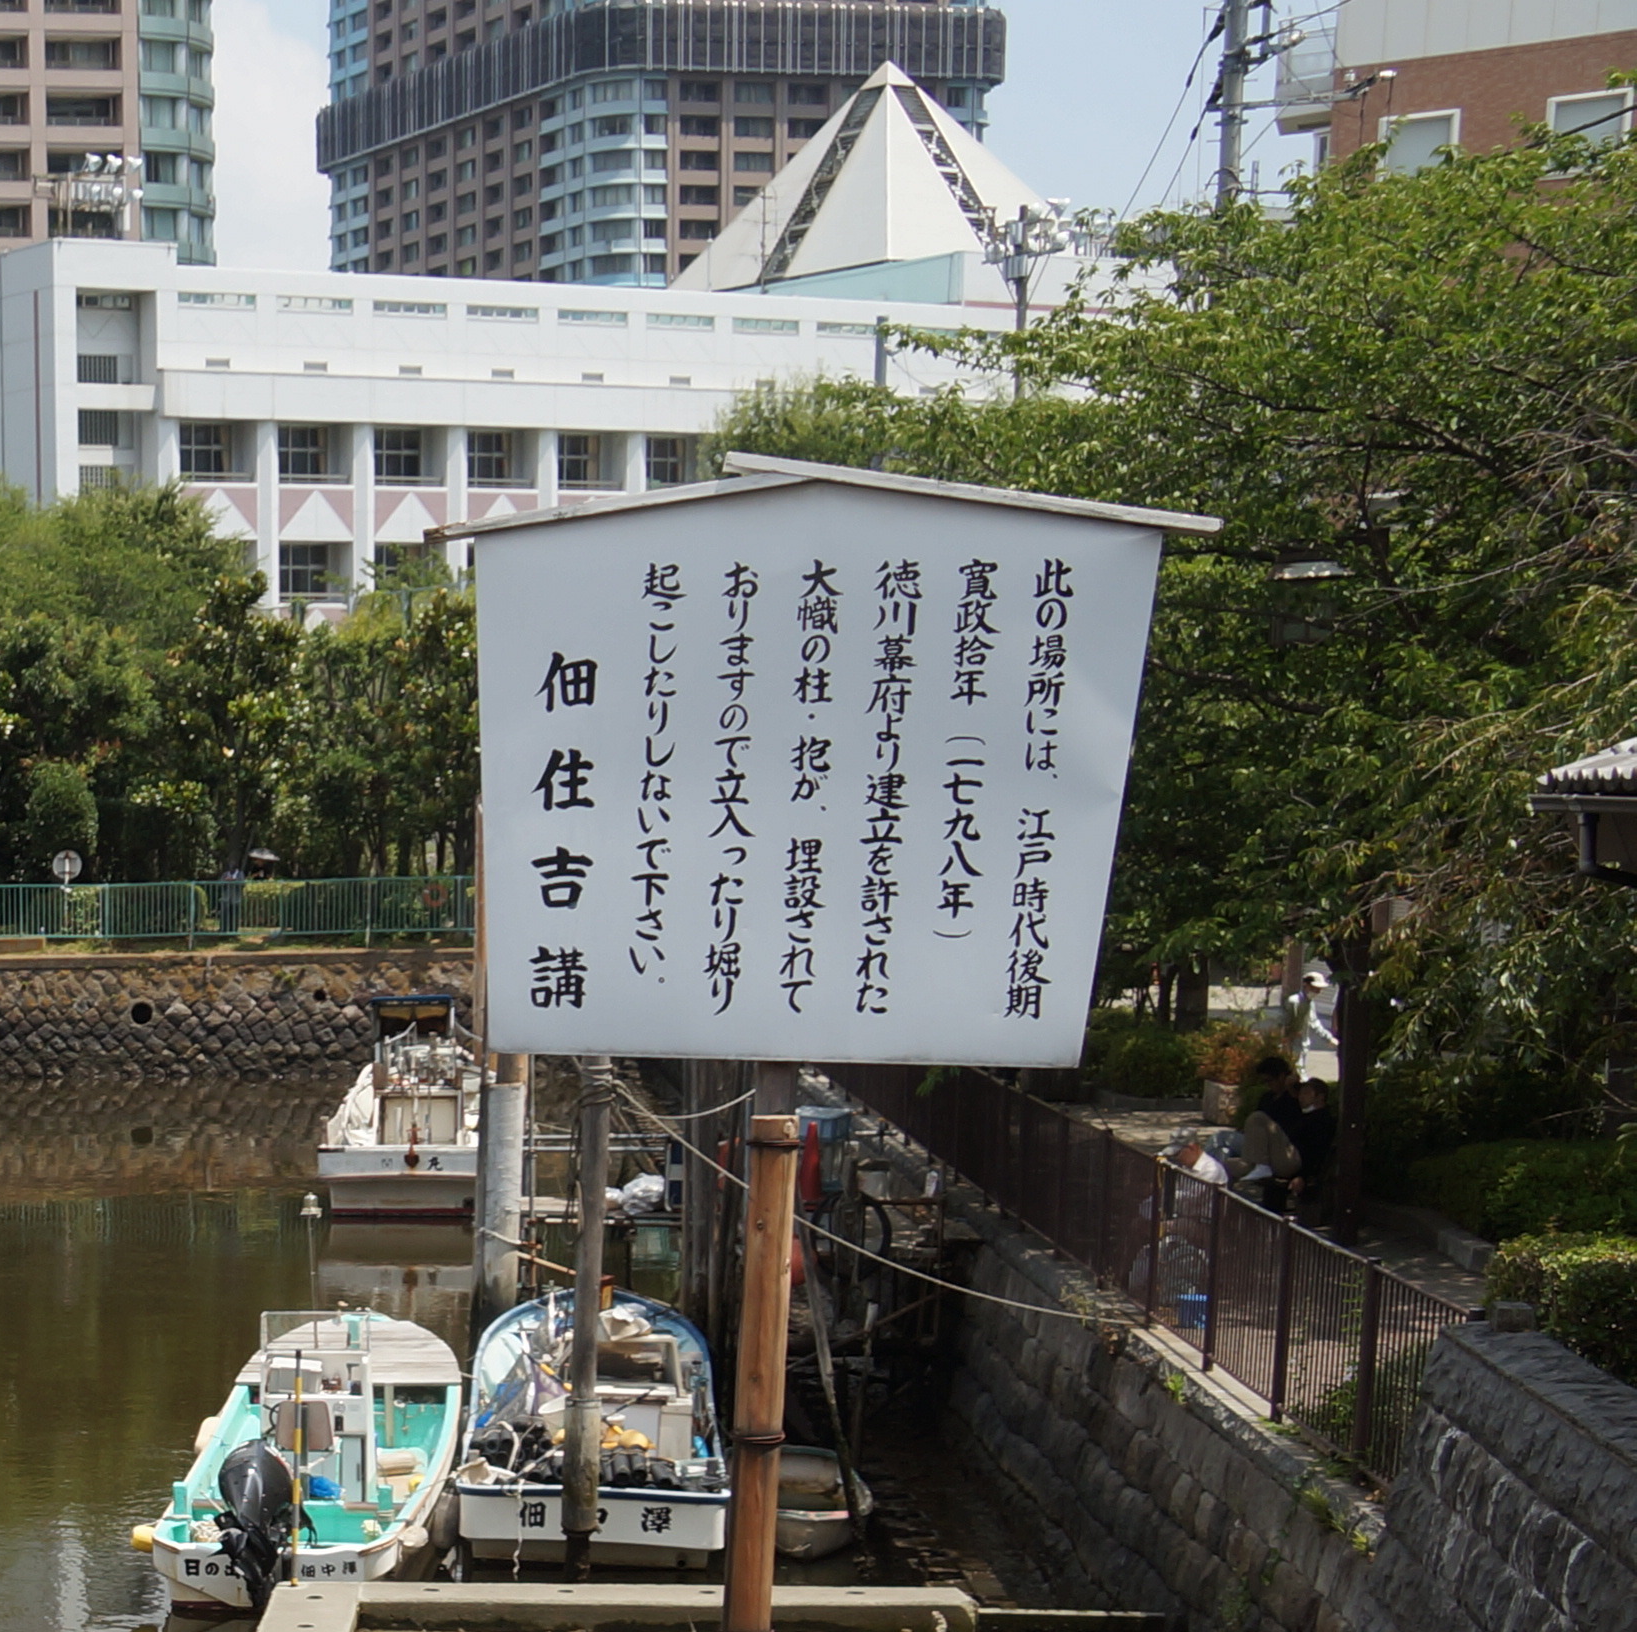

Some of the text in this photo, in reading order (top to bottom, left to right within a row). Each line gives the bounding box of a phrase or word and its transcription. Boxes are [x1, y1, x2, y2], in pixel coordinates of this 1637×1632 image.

[529, 650, 598, 1009] 佃住吉講
[628, 562, 688, 984] 起こしたりしないで下さい。
[855, 558, 924, 1015] 徳川幕府より建立を許された
[519, 1501, 673, 1534] 佃澤
